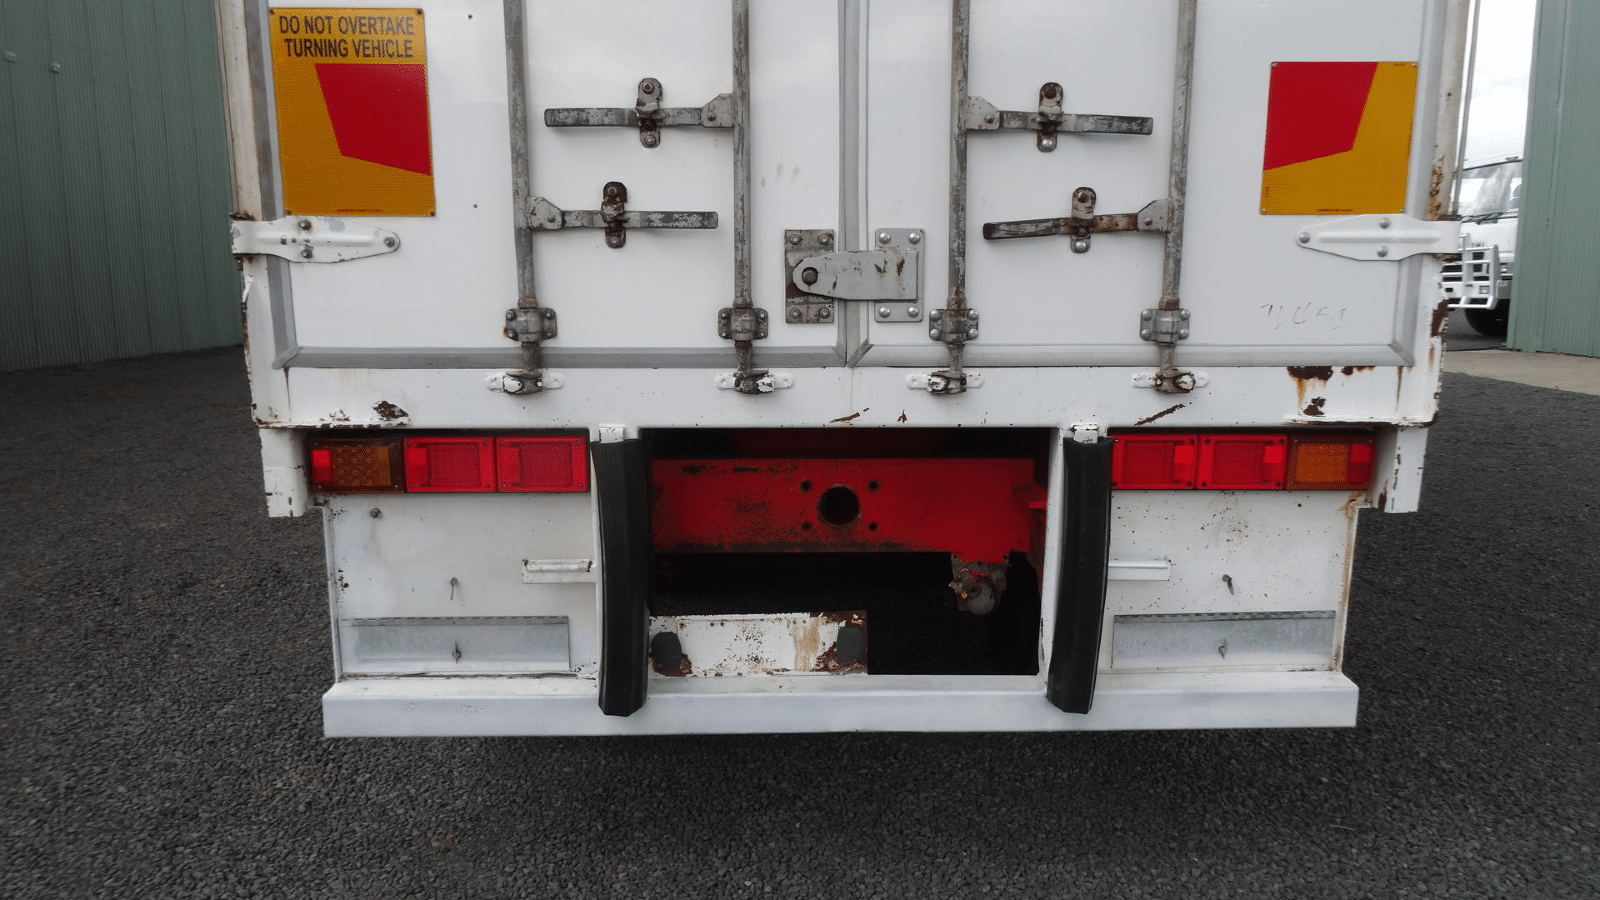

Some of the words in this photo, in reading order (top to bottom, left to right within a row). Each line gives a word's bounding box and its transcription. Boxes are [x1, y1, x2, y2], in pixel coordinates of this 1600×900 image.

[279, 15, 300, 34] DO
[304, 15, 333, 35] NOT
[338, 15, 415, 36] OVERTAKE
[284, 38, 349, 58] TURNING
[352, 38, 413, 58] VEHICLE
